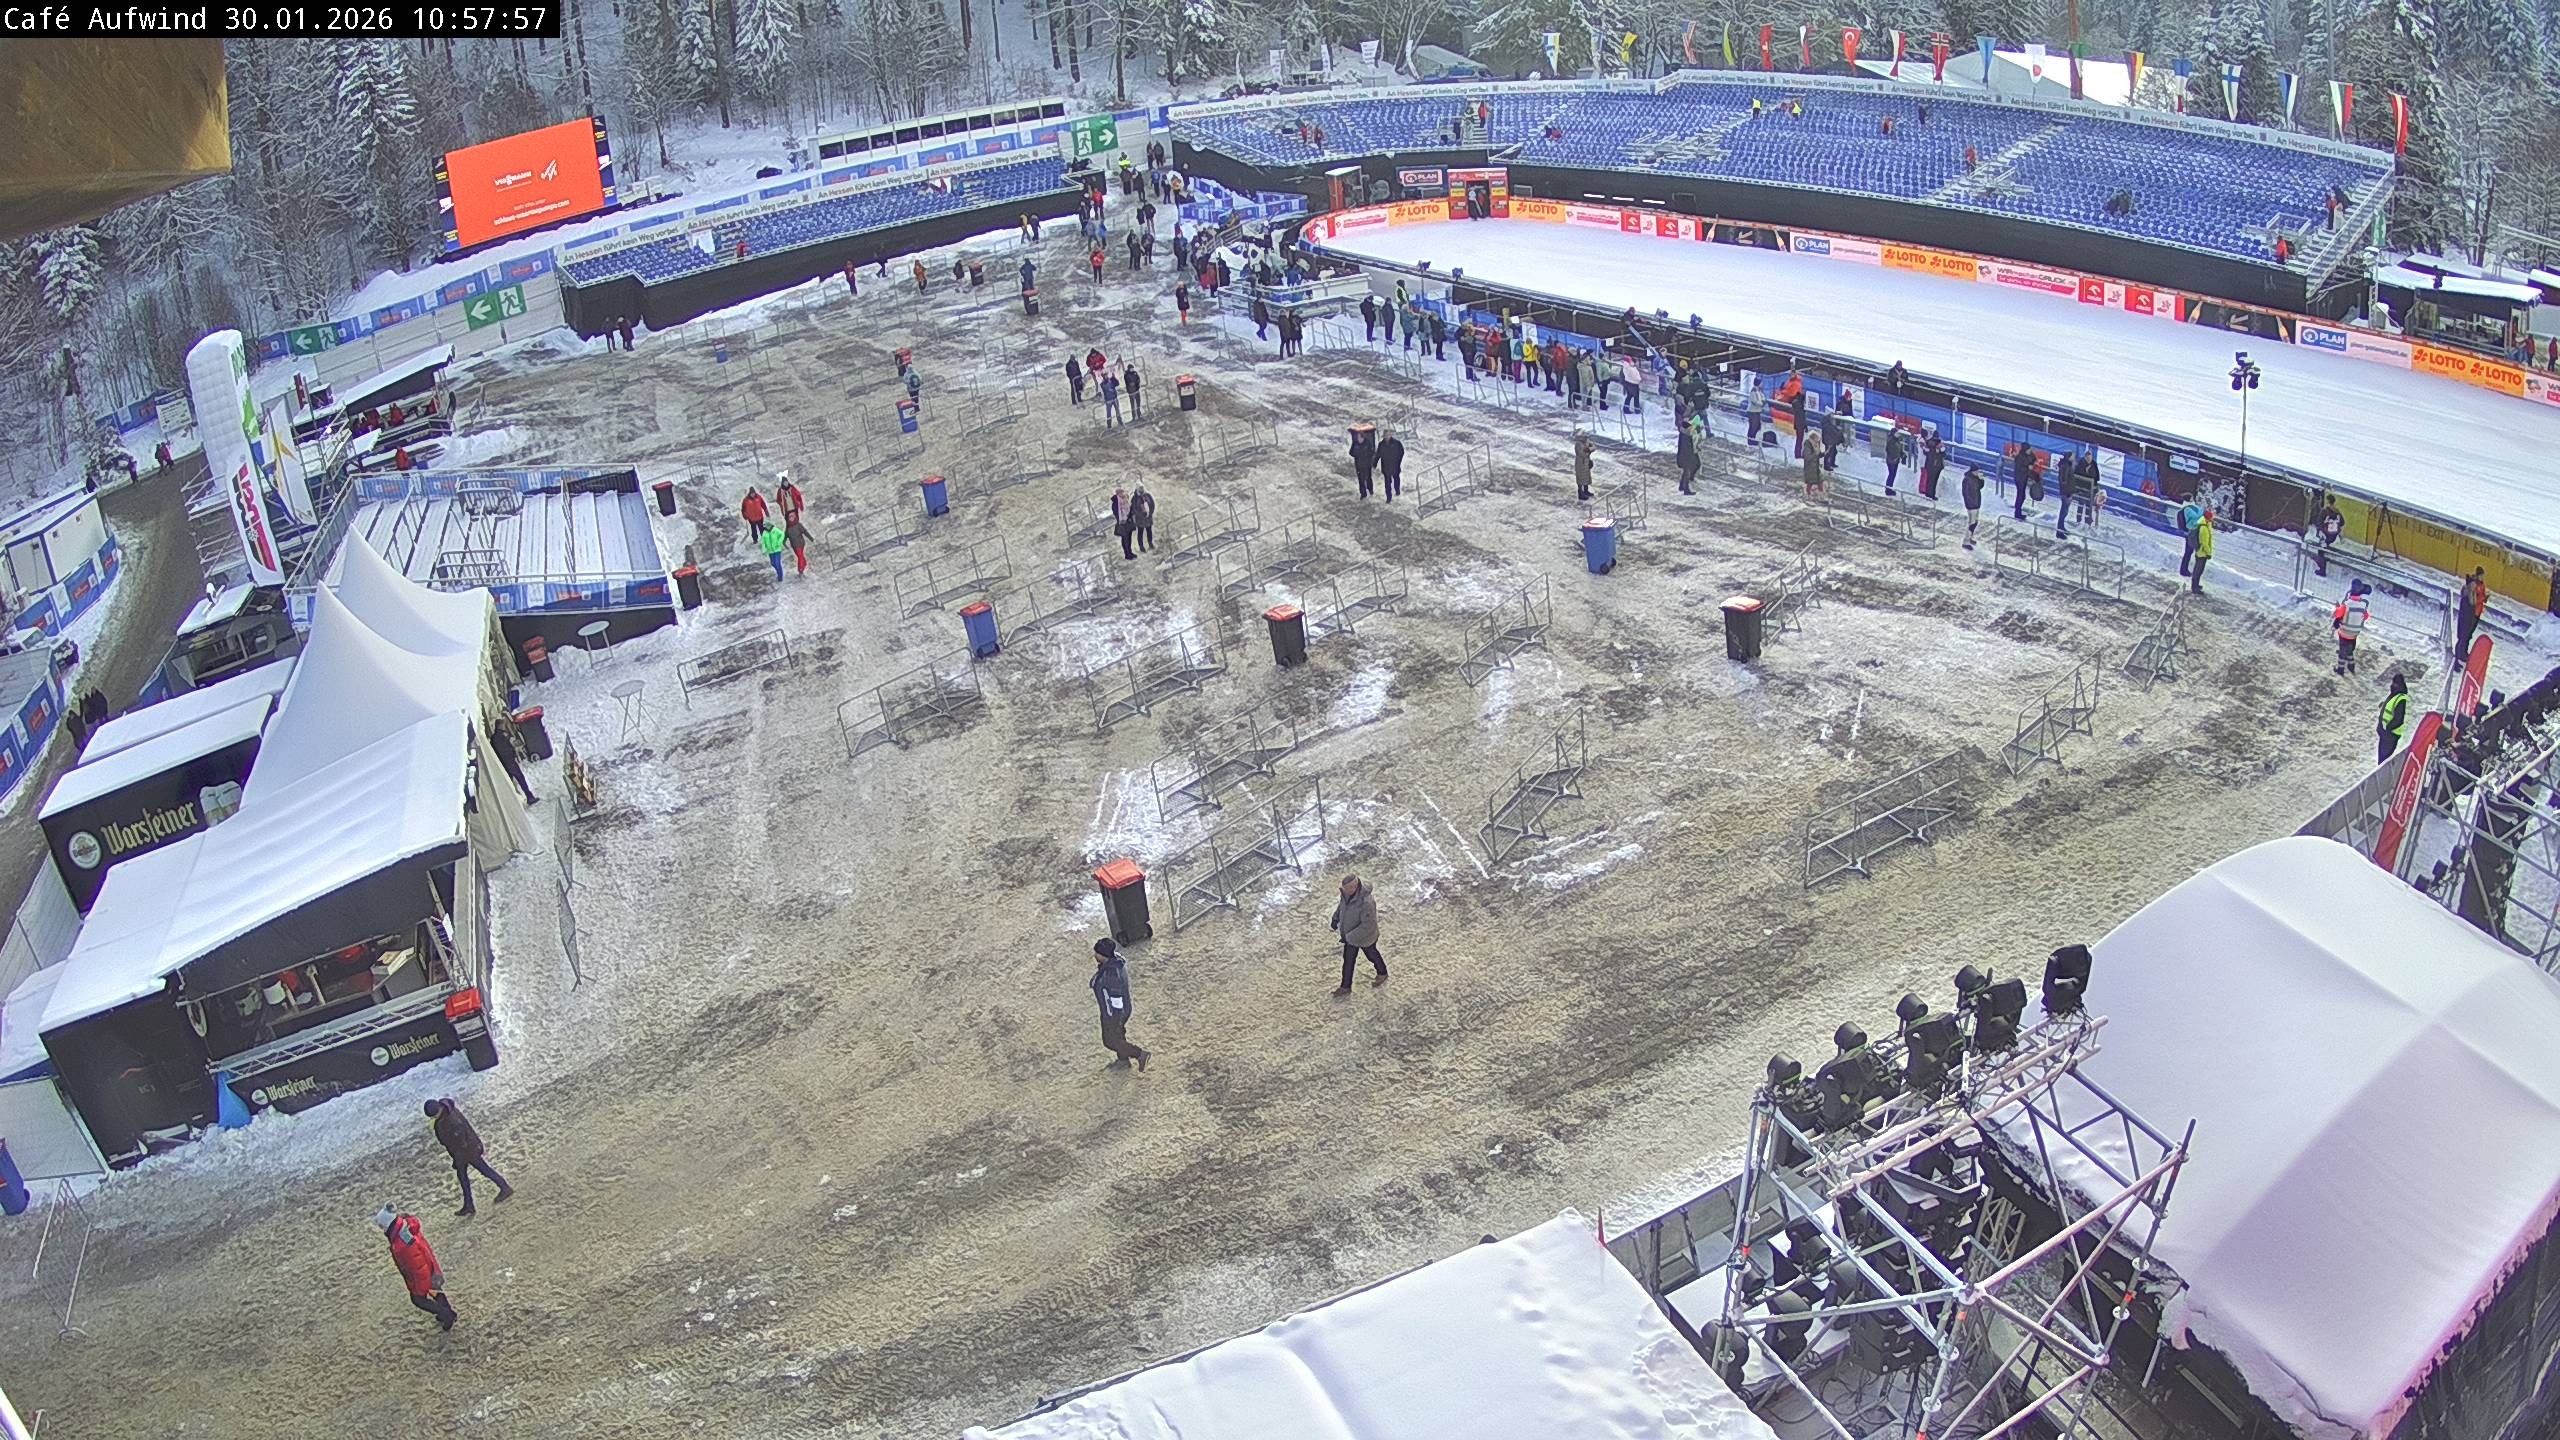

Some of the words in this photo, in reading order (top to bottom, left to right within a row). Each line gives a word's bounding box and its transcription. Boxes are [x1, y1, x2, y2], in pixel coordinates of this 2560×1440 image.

[2010, 97, 2020, 105] An
[2081, 106, 2096, 116] Weg
[2149, 115, 2178, 127] Hessen
[2276, 136, 2287, 145] An
[2287, 137, 2316, 151] Hessen
[929, 168, 939, 176] An
[817, 190, 827, 198] An
[828, 184, 853, 196] Hessen
[886, 175, 901, 185] Weg
[687, 220, 697, 228] An
[759, 201, 775, 212] Weg
[1407, 205, 1440, 216] LOTTO
[1528, 203, 1558, 215] LOTTO
[574, 246, 602, 258] Hessen
[638, 232, 654, 243] Weg
[1808, 240, 1829, 250] PLAN
[1897, 250, 1926, 264] LOTTO
[1943, 258, 1974, 272] LOTTO
[2319, 332, 2345, 345] PLAN
[2429, 352, 2466, 371] LOTTO
[2485, 366, 2522, 386] LOTTO
[2426, 527, 2445, 540] EXIT
[2472, 543, 2492, 557] EXIT
[101, 802, 198, 854] Warsteiner
[388, 1033, 441, 1060] Warsteiner
[265, 1075, 317, 1101] Warsteiner
